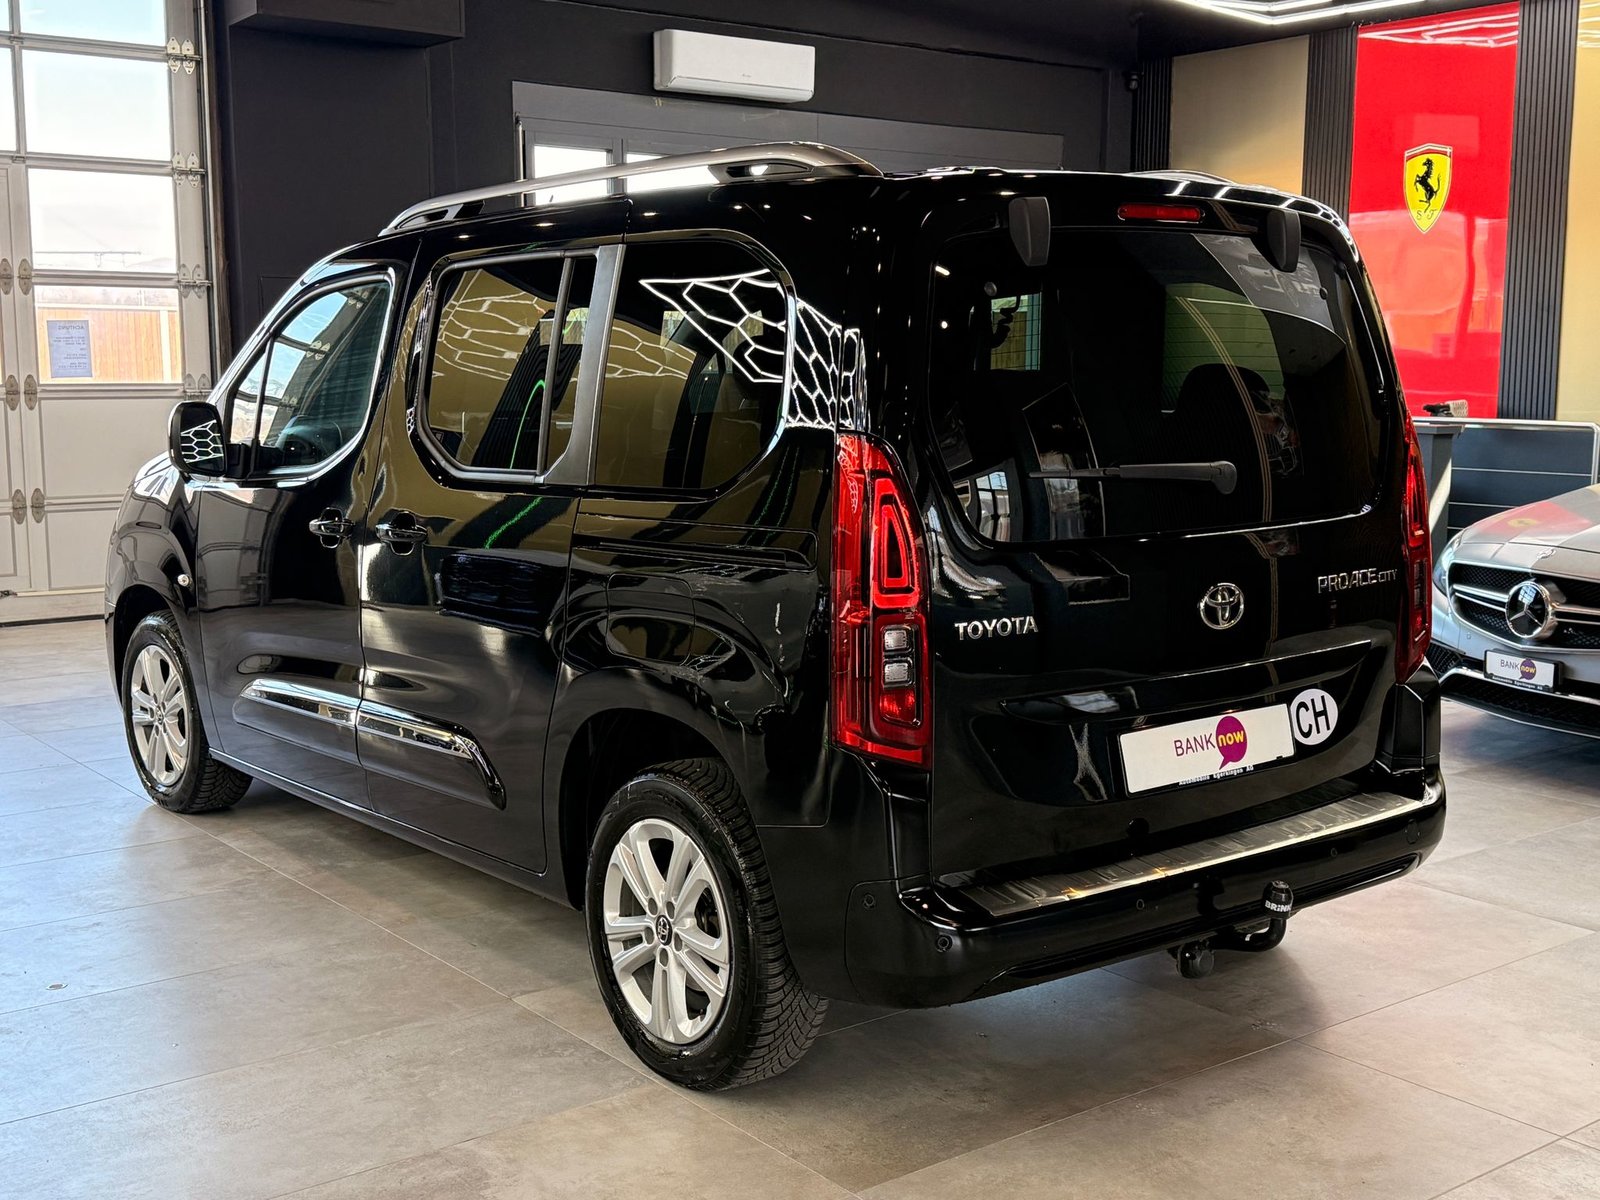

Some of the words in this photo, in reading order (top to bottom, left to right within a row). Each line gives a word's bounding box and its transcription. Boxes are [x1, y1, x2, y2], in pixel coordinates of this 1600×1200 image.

[1317, 567, 1377, 593] PROACE
[954, 615, 1039, 640] TOYOTA
[1500, 659, 1520, 671] BANK
[1520, 665, 1536, 674] now
[1295, 695, 1331, 739] CH
[1173, 732, 1216, 757] BANK
[1217, 730, 1245, 748] now
